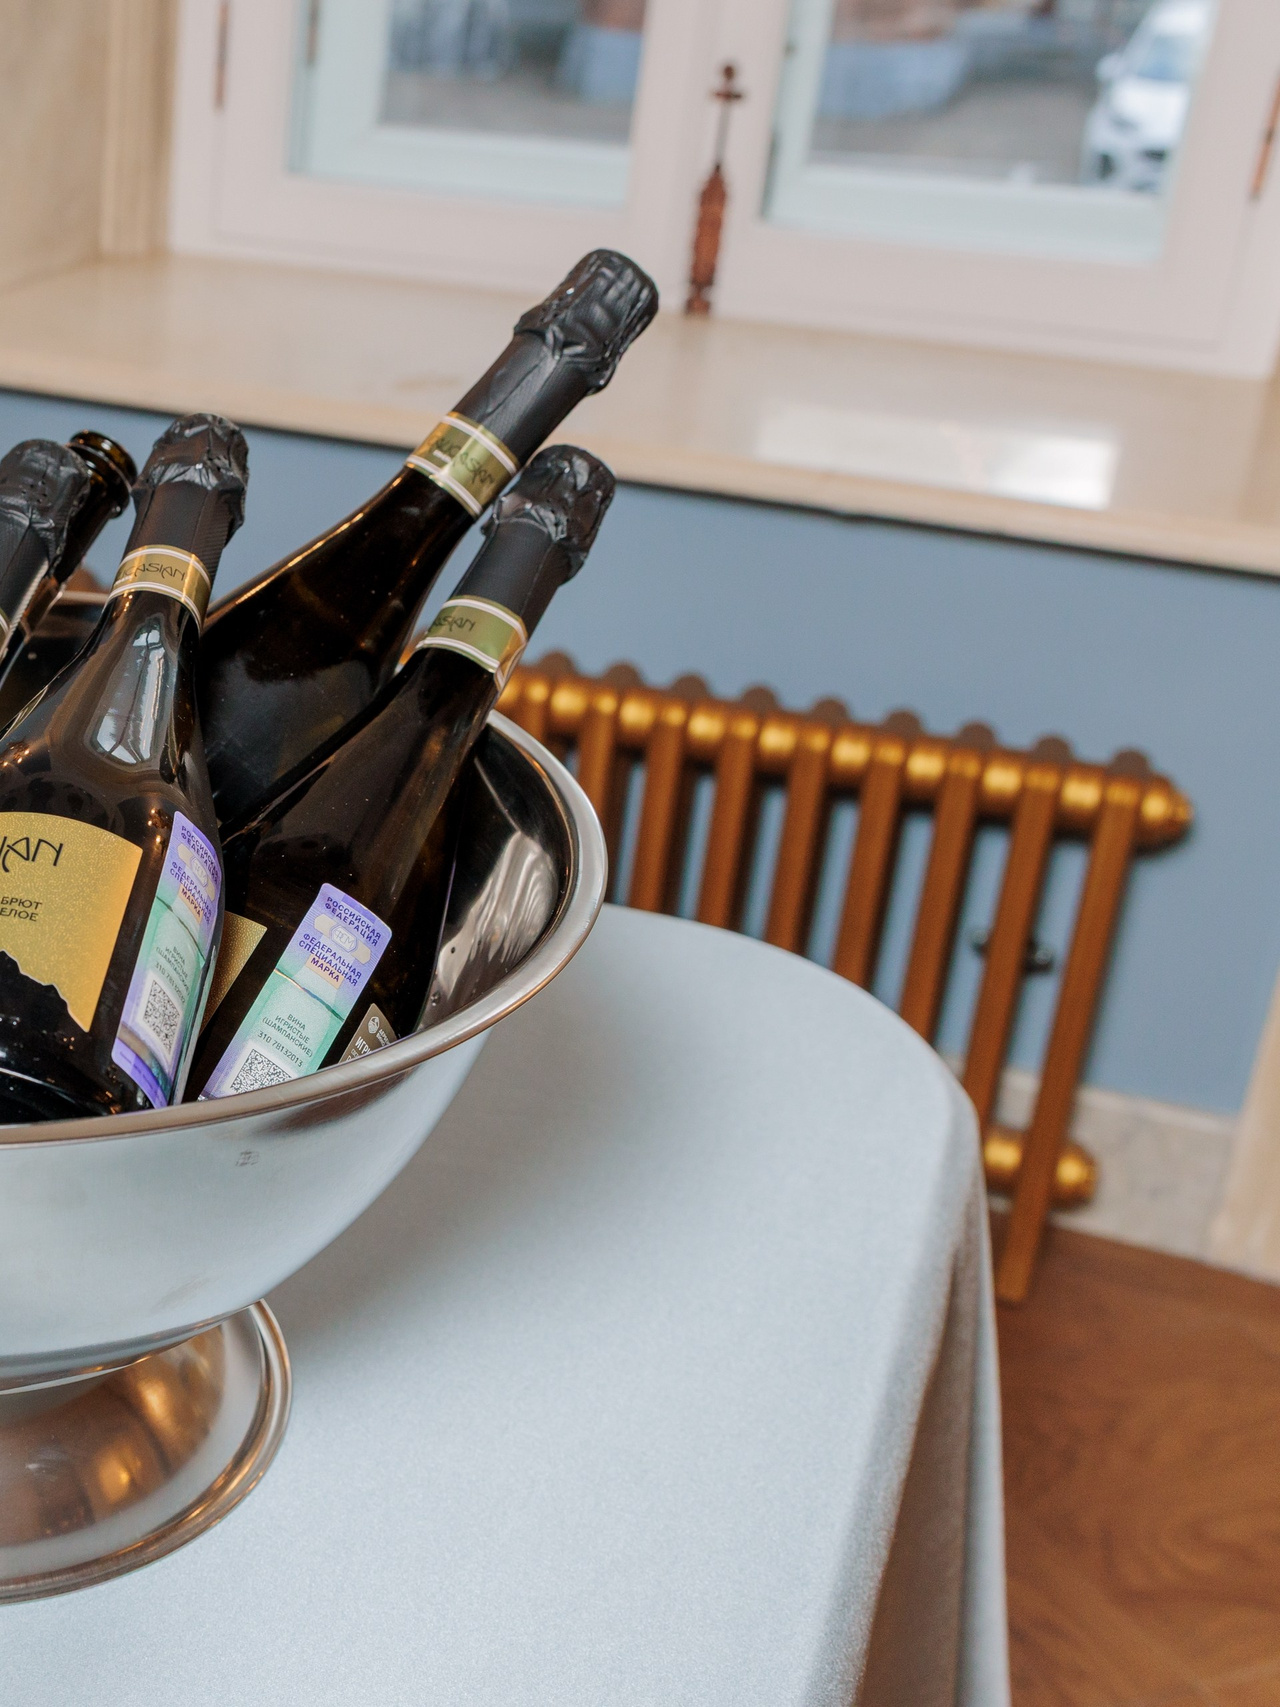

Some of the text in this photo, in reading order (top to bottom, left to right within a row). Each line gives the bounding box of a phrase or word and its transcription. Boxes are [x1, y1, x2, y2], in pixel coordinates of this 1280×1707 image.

[0, 896, 43, 911] БРЮТ
[181, 888, 201, 918] МАРКА
[326, 896, 381, 940] РОССИЙСКАЯ
[325, 903, 378, 946] ФЕДЕРАЦИЯ
[298, 940, 358, 986] СПЕЦИАЛЬНАЯ
[303, 933, 362, 980] ФЕДЕРАЛЬНАЯ
[310, 957, 340, 982] МАРКА
[262, 1016, 313, 1058] (ШАМПАНСКИЕ)
[275, 1015, 310, 1044] ИГРИСТЫЕ
[287, 1014, 306, 1031] ВИНА
[257, 1030, 304, 1068] 310 78132013
